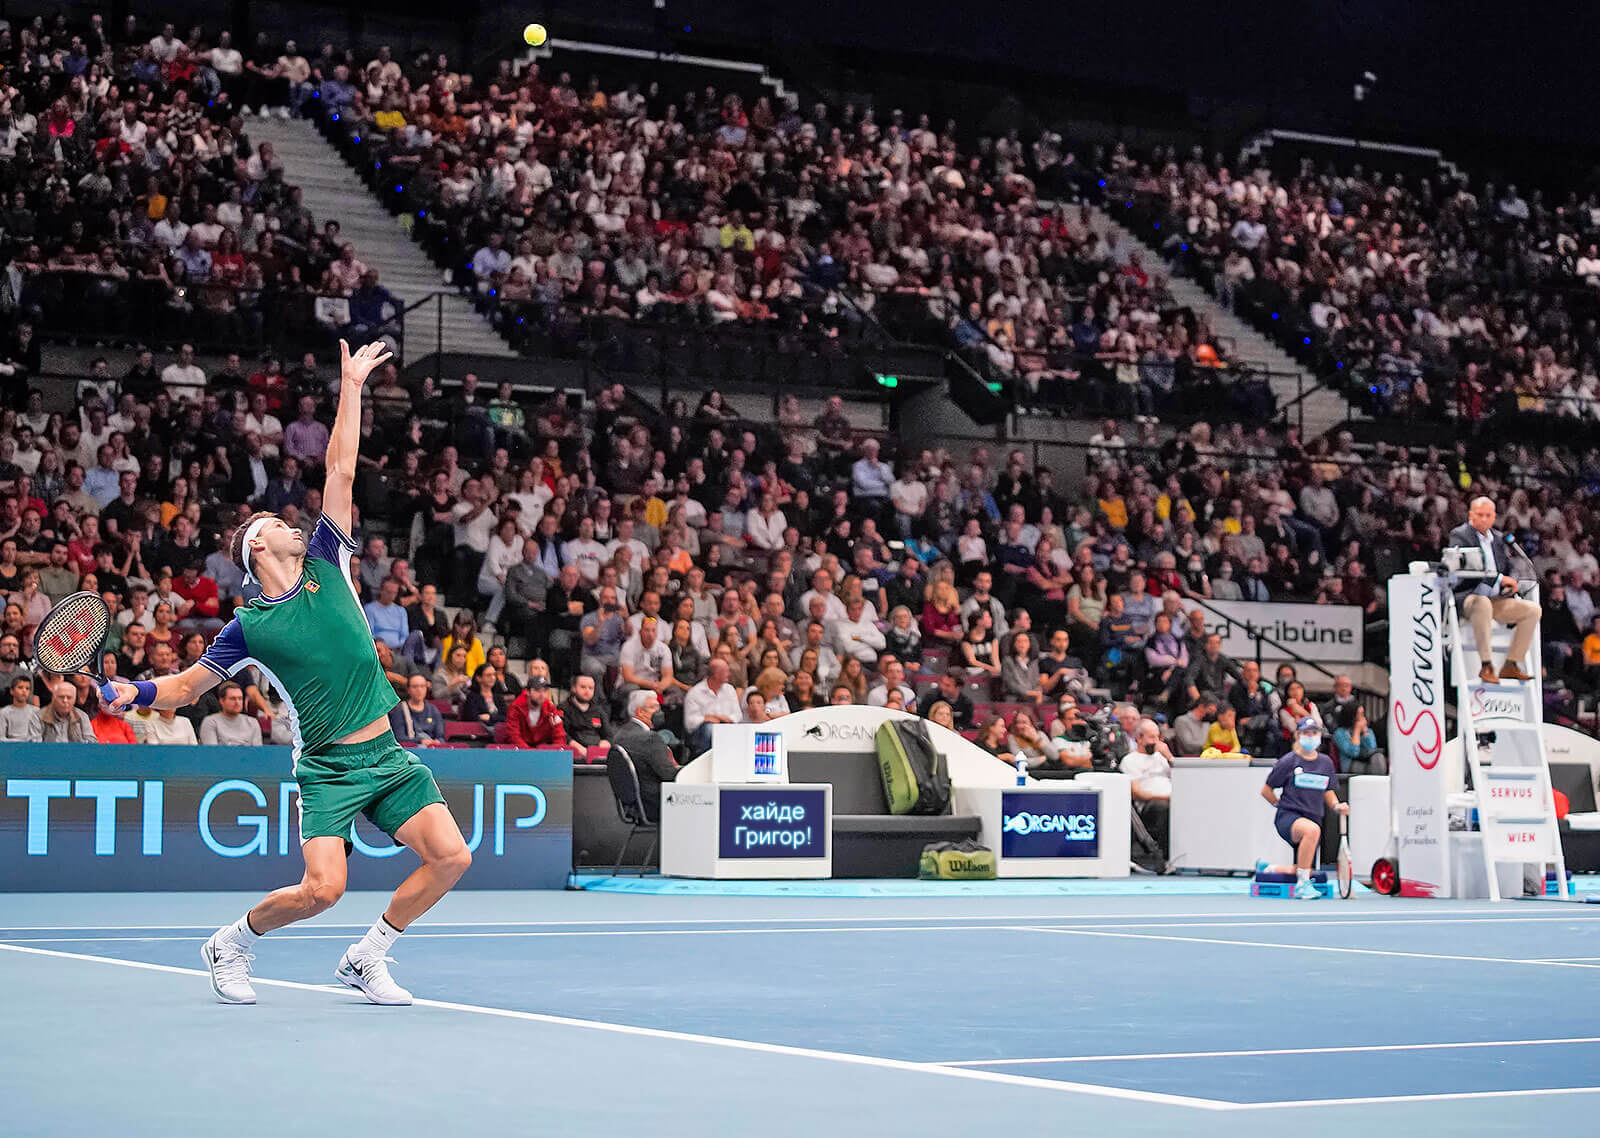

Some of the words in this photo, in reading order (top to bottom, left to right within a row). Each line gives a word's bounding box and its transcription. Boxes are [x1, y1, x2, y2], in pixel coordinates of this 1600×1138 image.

[1246, 619, 1352, 644] tribüne
[1491, 787, 1532, 798] SERVUS
[6, 780, 163, 855] TTI
[199, 779, 547, 858] GUP
[741, 802, 805, 824] хайде
[735, 826, 811, 850] Григор!
[1508, 832, 1536, 843] WIEN
[948, 859, 991, 873] Wilson
